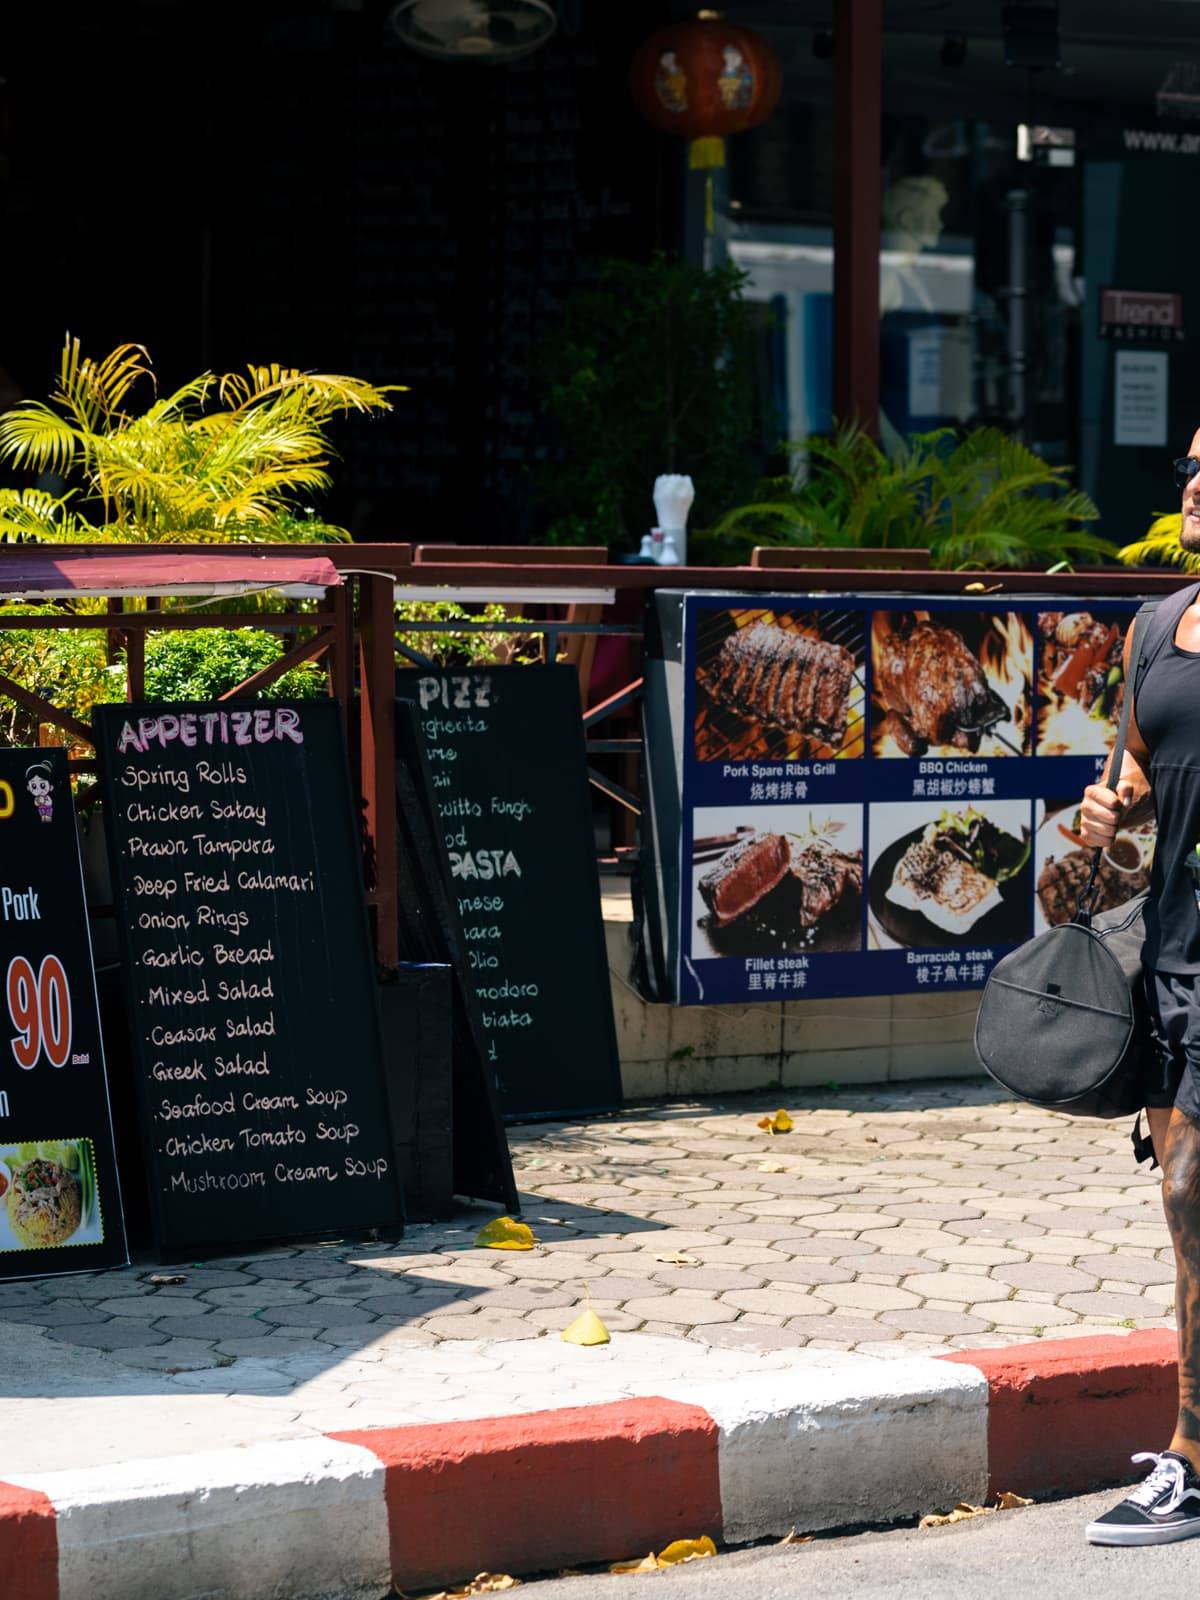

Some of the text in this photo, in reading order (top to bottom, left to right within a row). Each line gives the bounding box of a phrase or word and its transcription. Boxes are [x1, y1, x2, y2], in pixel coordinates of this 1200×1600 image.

[417, 673, 499, 713] PIZZ
[118, 708, 304, 753] APPETIZER
[121, 761, 247, 792] Spring Rolls
[723, 763, 835, 778] Pork Spare Ribs Grill
[919, 761, 988, 774] BBQ Chicken
[127, 800, 267, 826] Chicken Satay
[129, 833, 275, 860] Prawn Tampura
[135, 871, 314, 898] Deep Fried Calamari
[1, 886, 41, 921] Pork
[139, 906, 249, 935] Onion Rings
[143, 940, 274, 967] Garlic Bread
[745, 956, 809, 971] Fillet steak
[907, 948, 994, 964] Barracuda steak
[149, 977, 274, 1005] Mixed Salad
[6, 953, 73, 1070] 90
[152, 1012, 276, 1046] Ceasar Salad
[153, 1052, 270, 1081] Greek Salad
[160, 1088, 348, 1120] Seafood Cream Soup
[166, 1122, 360, 1156] Chicken Tomato Soup
[171, 1157, 388, 1194] Mushroom Cream Soup
